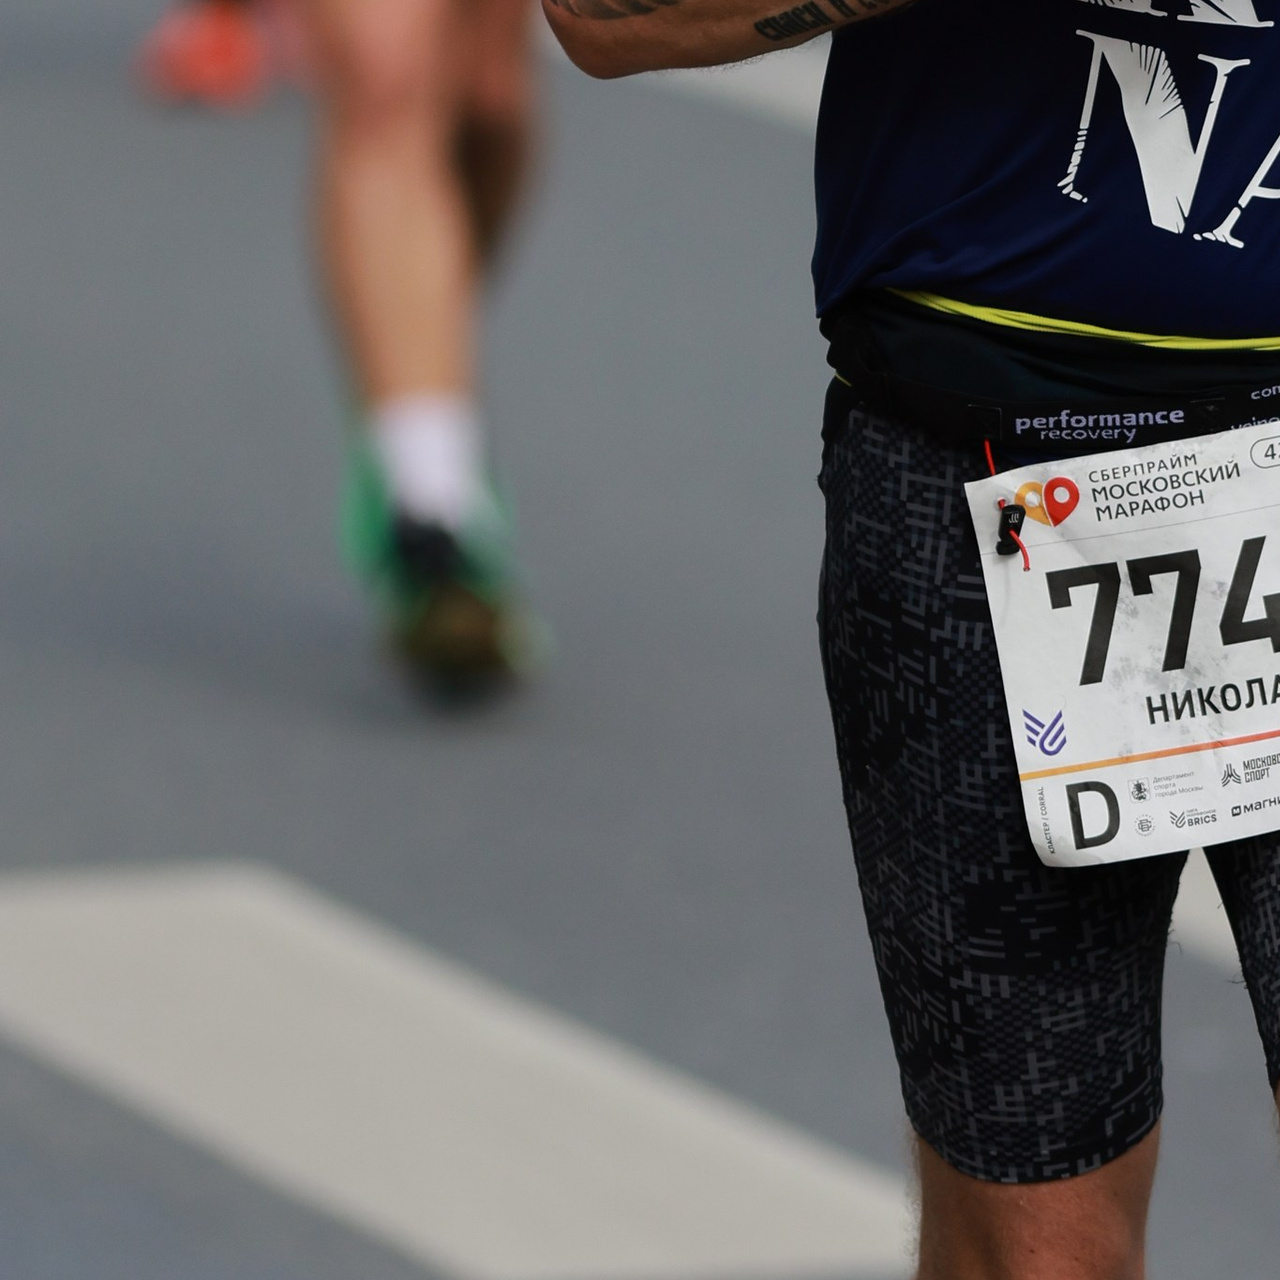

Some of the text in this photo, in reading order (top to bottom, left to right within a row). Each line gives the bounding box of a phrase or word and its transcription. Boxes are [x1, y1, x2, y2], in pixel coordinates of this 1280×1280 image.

[1015, 410, 1184, 434] performance
[1041, 428, 1136, 443] recovery
[1089, 453, 1198, 483] СБЕРПРАЙМ
[1091, 460, 1241, 503] МОСКОВСКИЙ
[1095, 489, 1205, 521] МАРАФОН
[1153, 771, 1195, 784] Департамент
[1154, 782, 1176, 791] спорта
[1244, 767, 1271, 783] СПОРТ
[1037, 787, 1047, 816] CORRAL
[1155, 785, 1203, 799] города Москвы
[1065, 781, 1120, 850] D
[1188, 814, 1217, 828] BRICS
[1043, 822, 1056, 854] КЛАСТЕР
